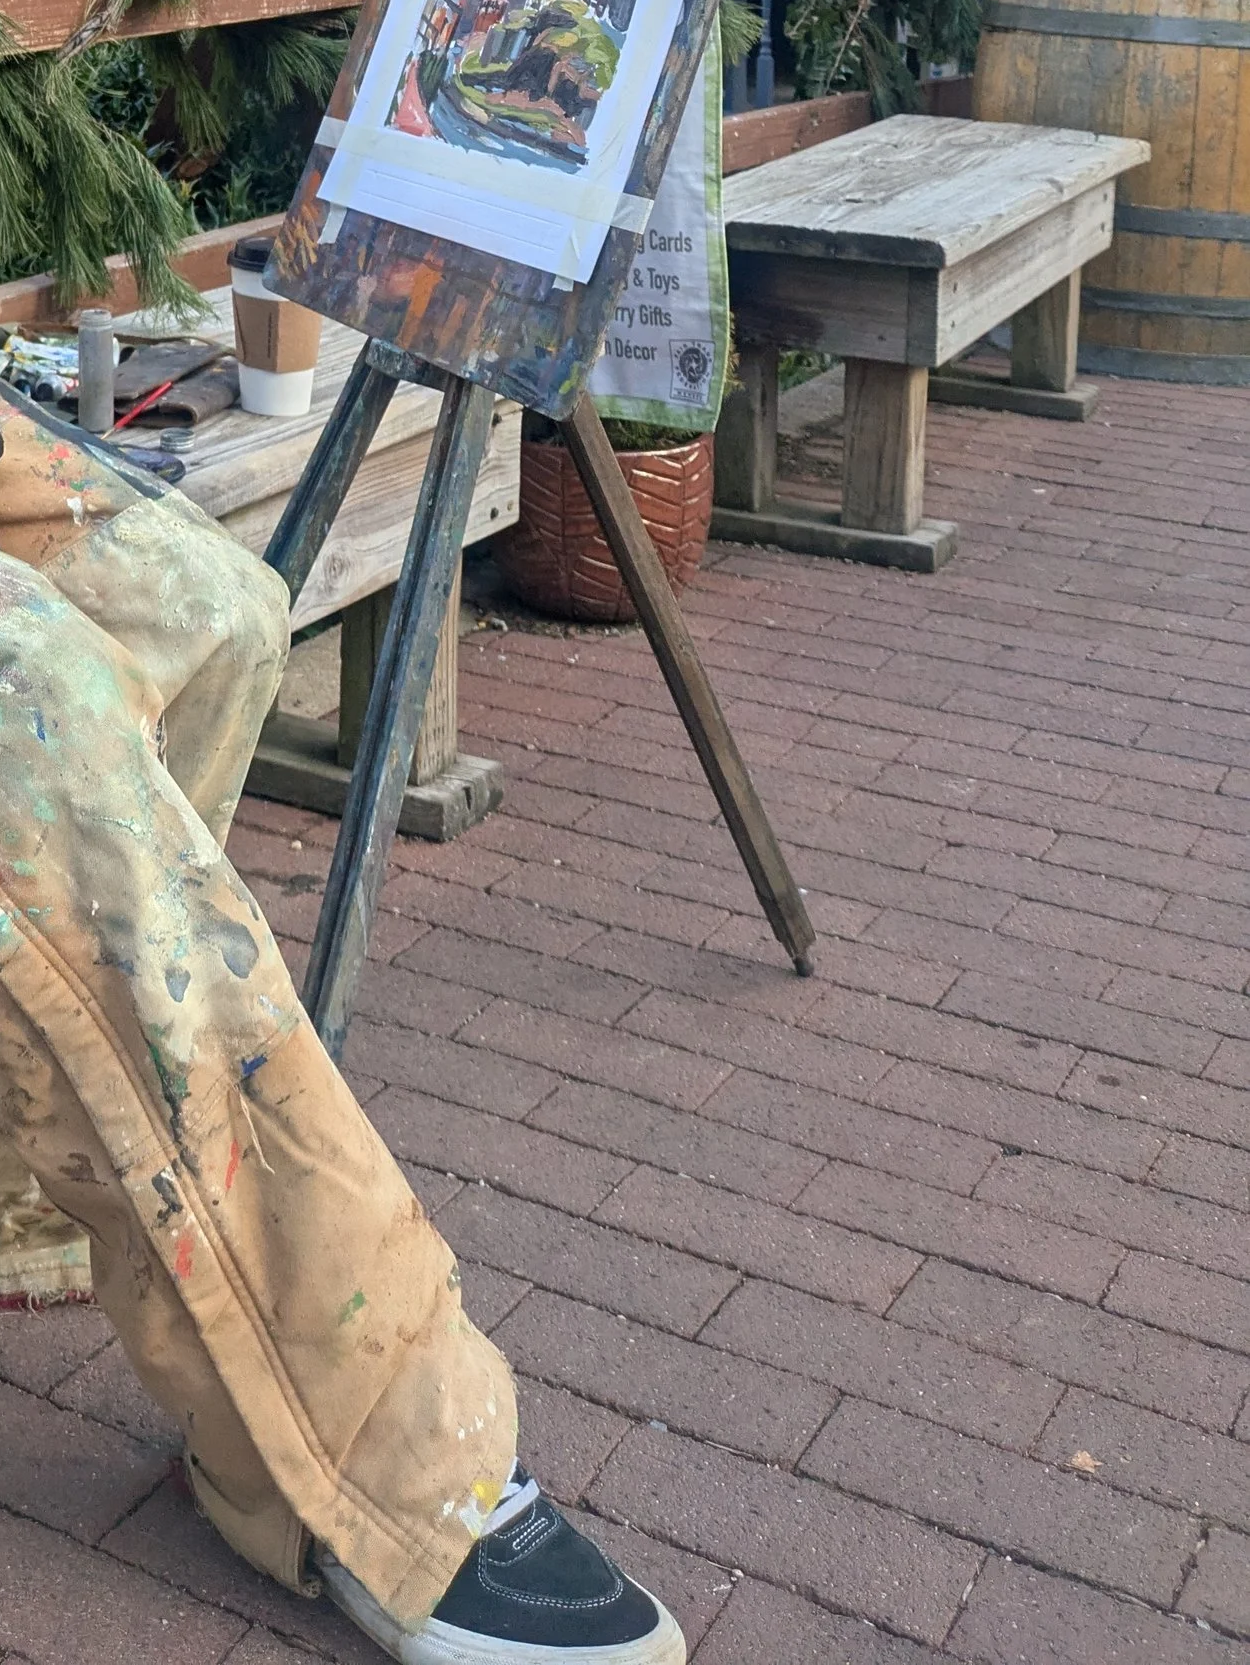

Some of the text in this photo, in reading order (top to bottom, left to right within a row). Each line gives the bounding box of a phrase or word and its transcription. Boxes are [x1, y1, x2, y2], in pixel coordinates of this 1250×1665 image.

[649, 229, 692, 252] Cards
[632, 268, 644, 288] &
[647, 267, 680, 295] Toys
[615, 303, 672, 328] rry Gifts
[614, 337, 658, 361] Décor
